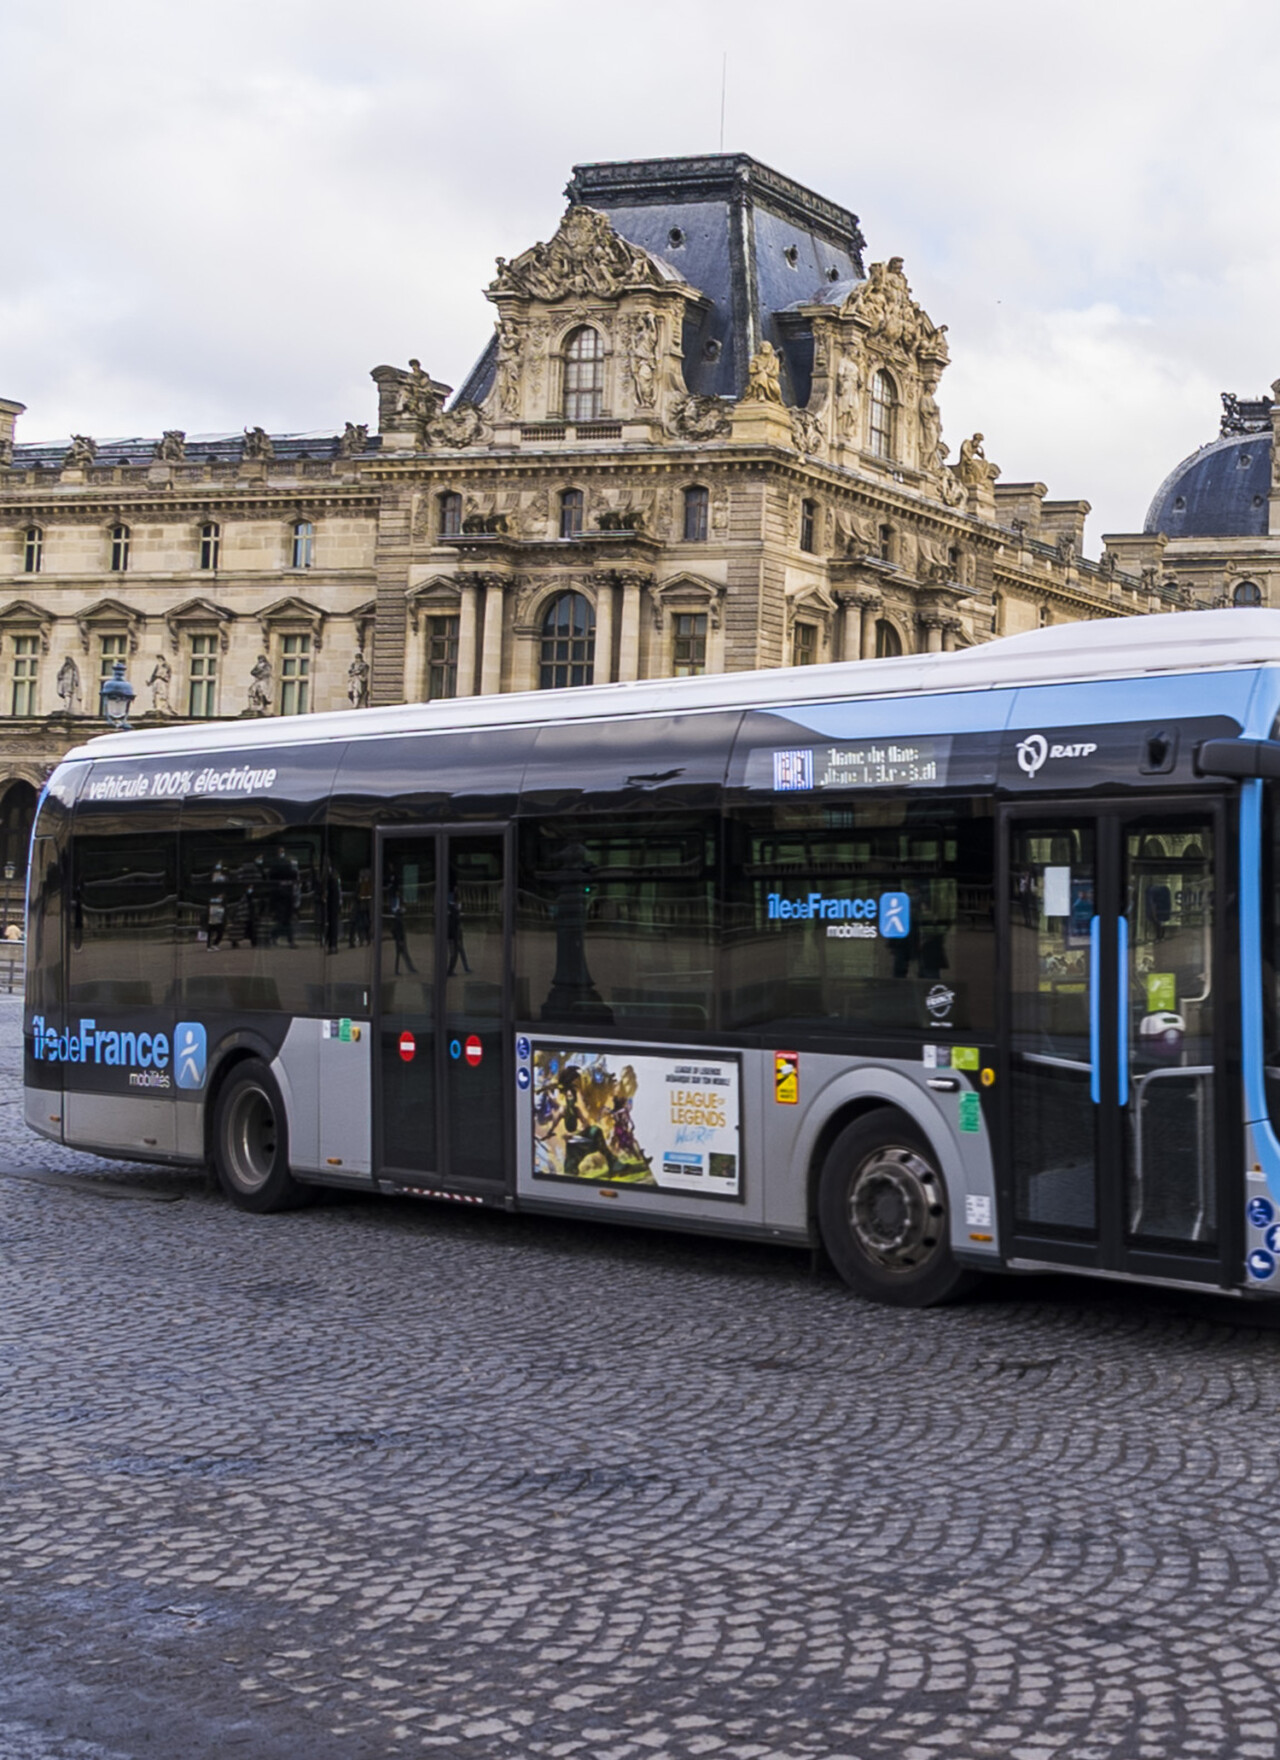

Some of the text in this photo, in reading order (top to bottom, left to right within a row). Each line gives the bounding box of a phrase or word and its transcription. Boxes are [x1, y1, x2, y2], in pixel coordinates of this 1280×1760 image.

[1049, 743, 1098, 758] RATP
[89, 764, 278, 800] véhicule 100% électrique
[826, 922, 878, 938] mobilités
[129, 1070, 171, 1088] mobilités
[670, 1090, 718, 1109] LEAGUE
[670, 1107, 726, 1128] LEGENDS
